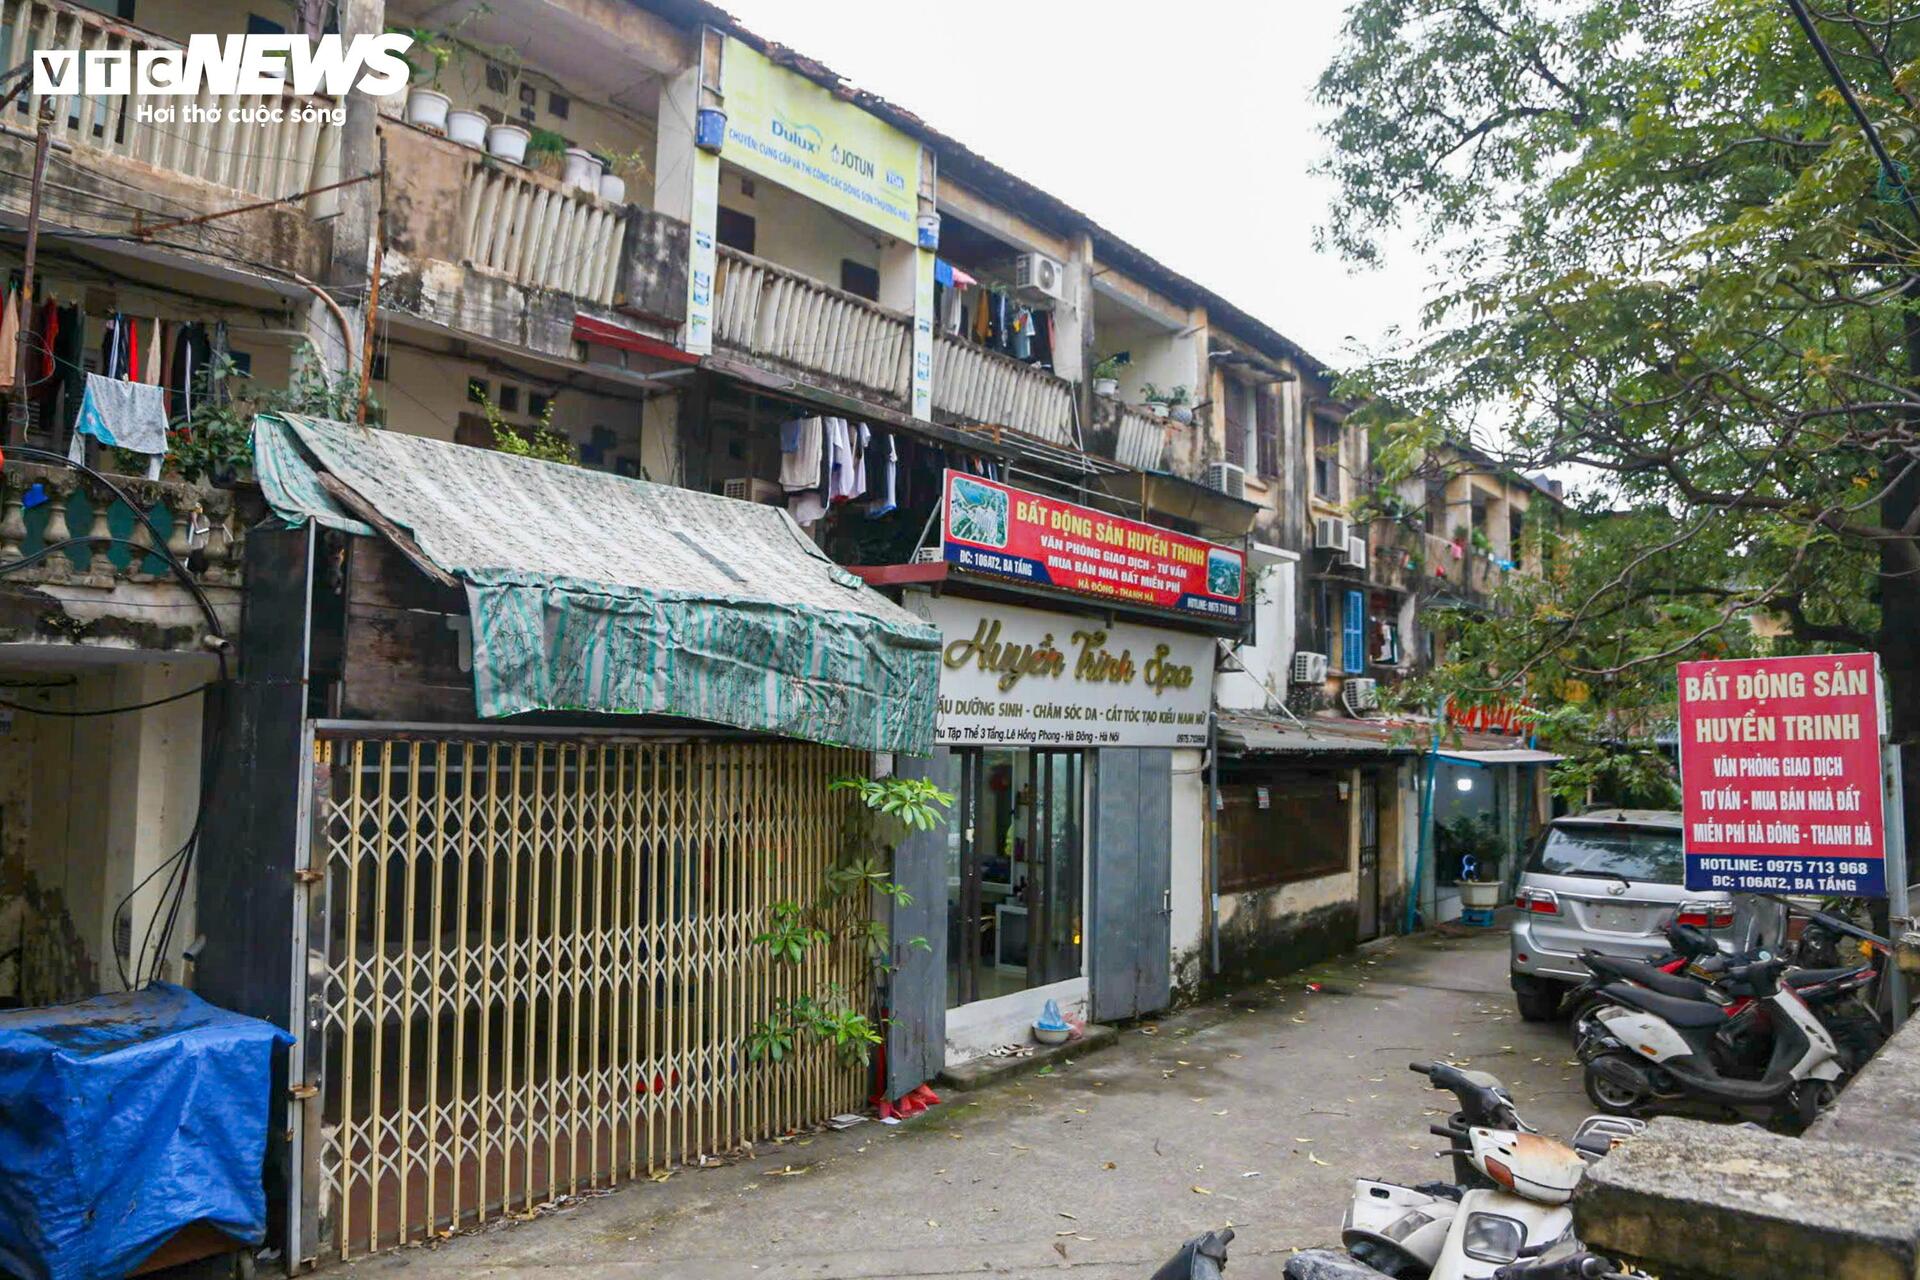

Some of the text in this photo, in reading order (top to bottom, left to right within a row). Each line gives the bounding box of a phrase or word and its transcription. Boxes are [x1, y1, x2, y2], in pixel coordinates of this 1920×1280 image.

[771, 119, 815, 153] Dulux
[841, 149, 874, 179] JOTUN
[1017, 500, 1048, 525] BẤT
[1051, 511, 1092, 539] ĐỘNG
[1095, 515, 1125, 546] SẢN
[1171, 542, 1205, 566] TRINH
[1003, 559, 1013, 573] BA
[1040, 534, 1063, 549] VĂN
[1066, 539, 1101, 560] PHÒNG
[1103, 550, 1126, 565] GIAO
[1127, 556, 1149, 571] DỊCH
[1048, 556, 1073, 571] MUA
[1074, 559, 1097, 576] BÁN
[1098, 564, 1119, 580] NHÀ
[1144, 643, 1195, 696] Spa
[1685, 661, 1868, 705] BẤT ĐỘNG SẢN
[955, 696, 995, 716] DƯỠNG
[999, 702, 1022, 717] SINH
[1033, 701, 1062, 719] CHĂM
[1064, 703, 1082, 720] SÓC
[1085, 707, 1098, 720] DA
[1105, 704, 1123, 721] CẮT
[1124, 707, 1140, 722] TÓC
[1142, 710, 1158, 726] TẠO
[947, 727, 962, 741] Tập
[981, 728, 986, 739] 3
[1038, 730, 1060, 745] Phong
[1783, 714, 1860, 741] TRINH
[1713, 753, 1843, 781] VĂN PHÒNG GIAO DỊCH
[1700, 789, 1716, 810] TƯ
[1717, 784, 1741, 810] VẤN
[1751, 790, 1778, 811] MUA
[1780, 787, 1805, 811] BÁN
[1808, 787, 1834, 811] NHÀ
[1836, 784, 1860, 811] ĐẤT
[1725, 820, 1745, 843] PHÍ
[1747, 821, 1765, 844] HÀ
[1766, 820, 1800, 844] ĐÔNG
[1810, 824, 1852, 845] THANH
[1854, 821, 1873, 846] HÀ
[1700, 858, 1868, 875] HOTLINE: 0975 713 968
[1712, 875, 1735, 888] ĐC:
[1795, 876, 1814, 890] BA
